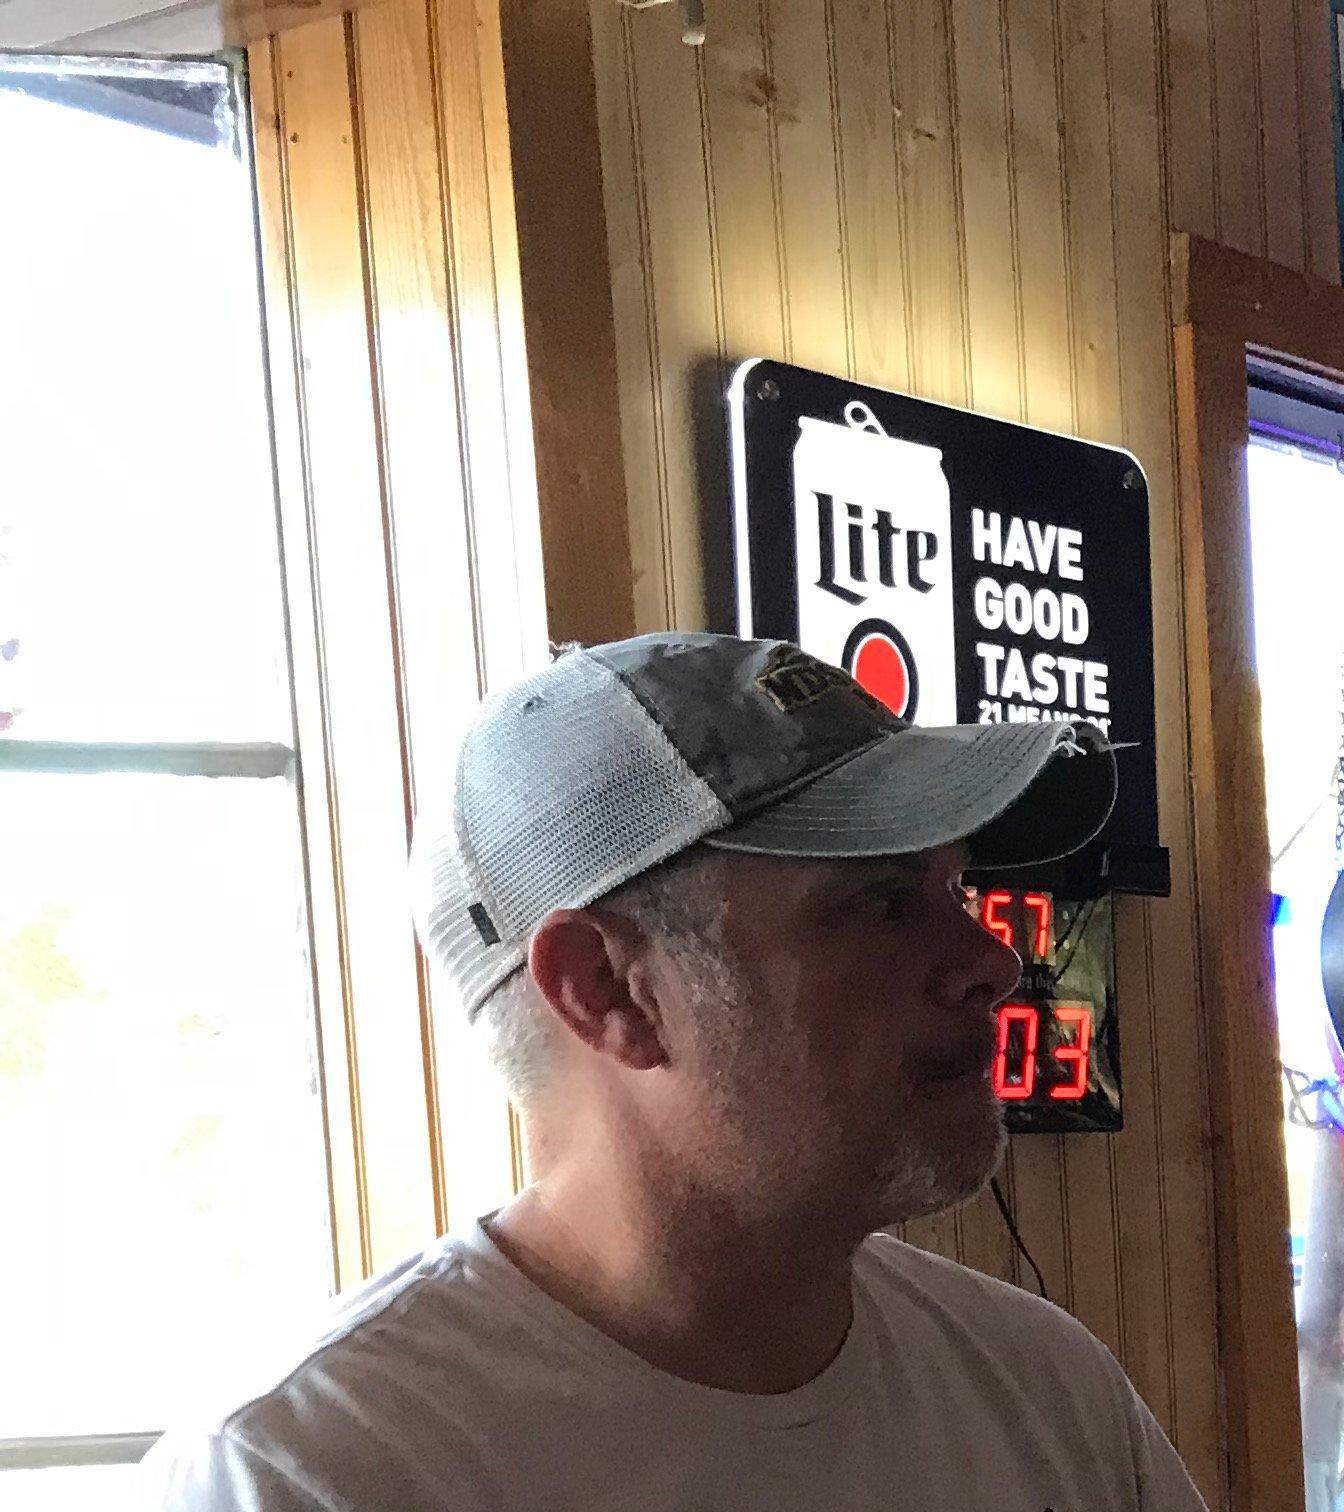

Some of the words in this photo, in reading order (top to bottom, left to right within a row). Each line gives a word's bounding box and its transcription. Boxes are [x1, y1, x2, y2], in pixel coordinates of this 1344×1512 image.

[810, 490, 938, 606] Lite
[970, 508, 1083, 582] HAVE
[974, 577, 1089, 645] GOOD
[976, 642, 1110, 714] TASTE
[978, 700, 1002, 725] 21
[994, 1004, 1093, 1101] 03
